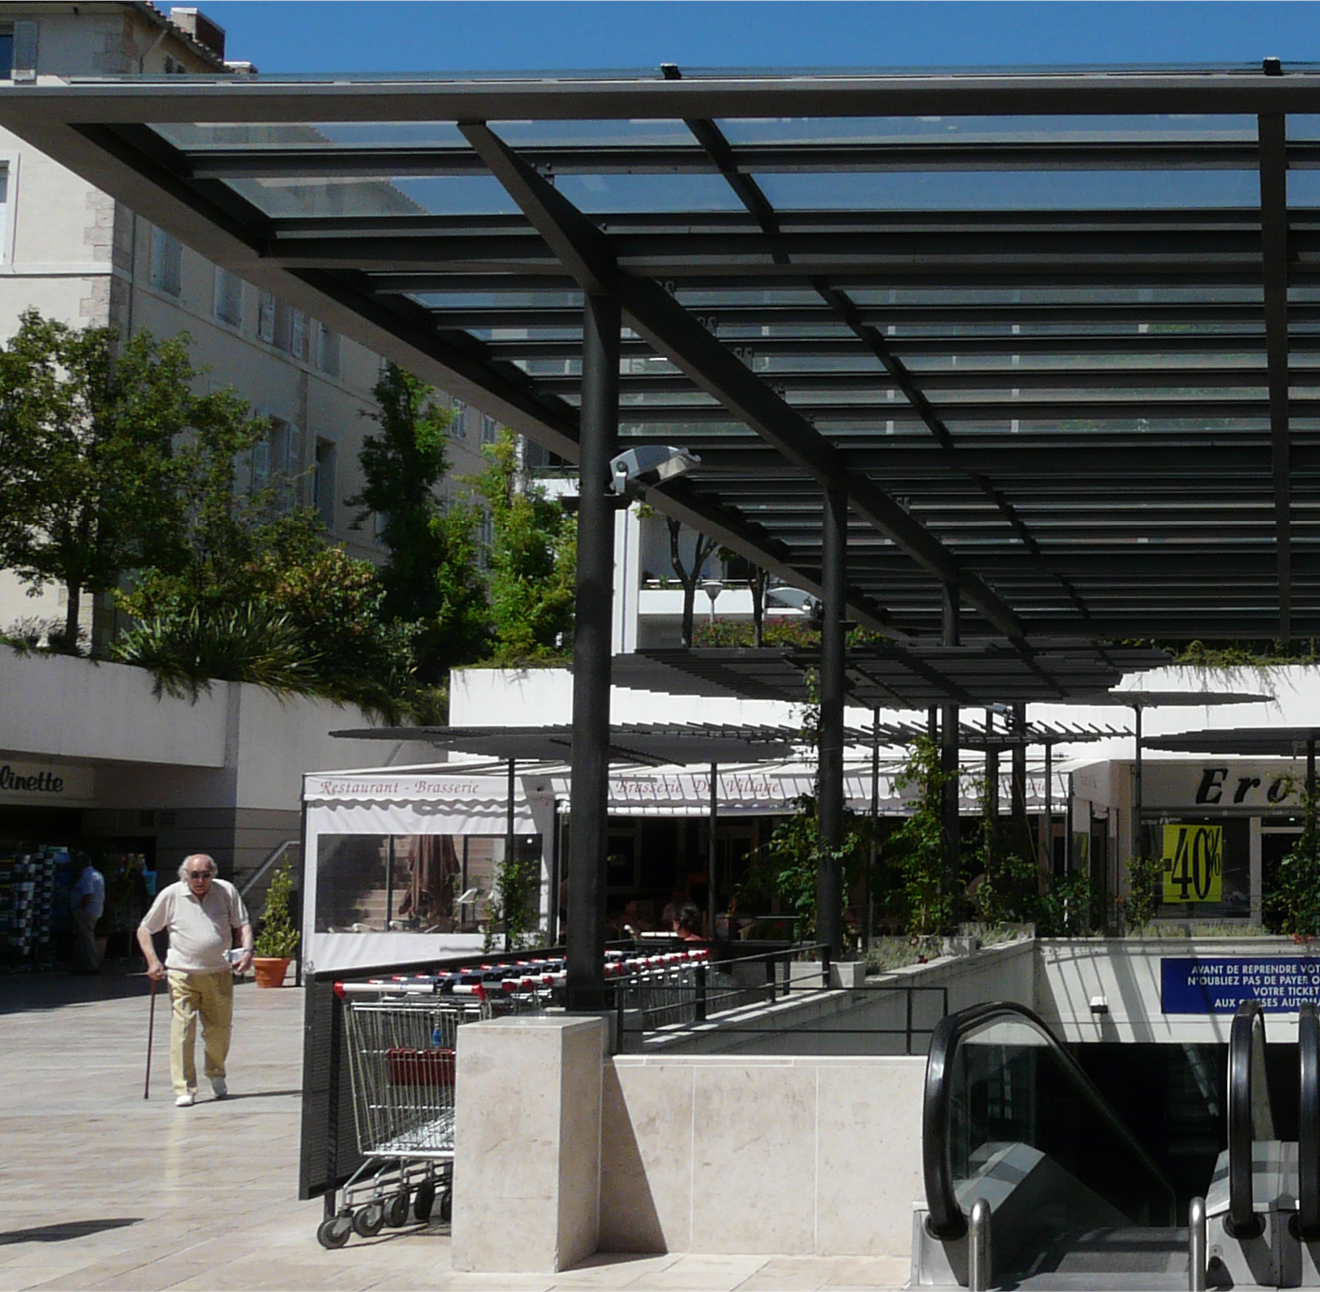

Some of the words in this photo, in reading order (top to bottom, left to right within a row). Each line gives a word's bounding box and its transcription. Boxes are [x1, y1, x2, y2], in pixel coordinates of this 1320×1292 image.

[0, 765, 64, 792] linette
[320, 780, 399, 795] Restaurant
[414, 780, 479, 794] Brasserie
[616, 779, 682, 794] Brasserie
[727, 778, 779, 797] Village
[1163, 827, 1221, 900] -40%
[1191, 964, 1223, 975] AVANT
[1226, 964, 1239, 974] DE
[1242, 964, 1297, 974] REPRENDRE
[1187, 975, 1240, 986] N'OUBLIEZ
[1242, 975, 1261, 985] PAS
[1263, 975, 1277, 985] DE
[1279, 975, 1309, 985] PAYER
[1253, 986, 1284, 996] VOTRE
[1287, 986, 1320, 996] TICKET
[1214, 998, 1236, 1008] AUX
[1239, 997, 1278, 1008] CSES
